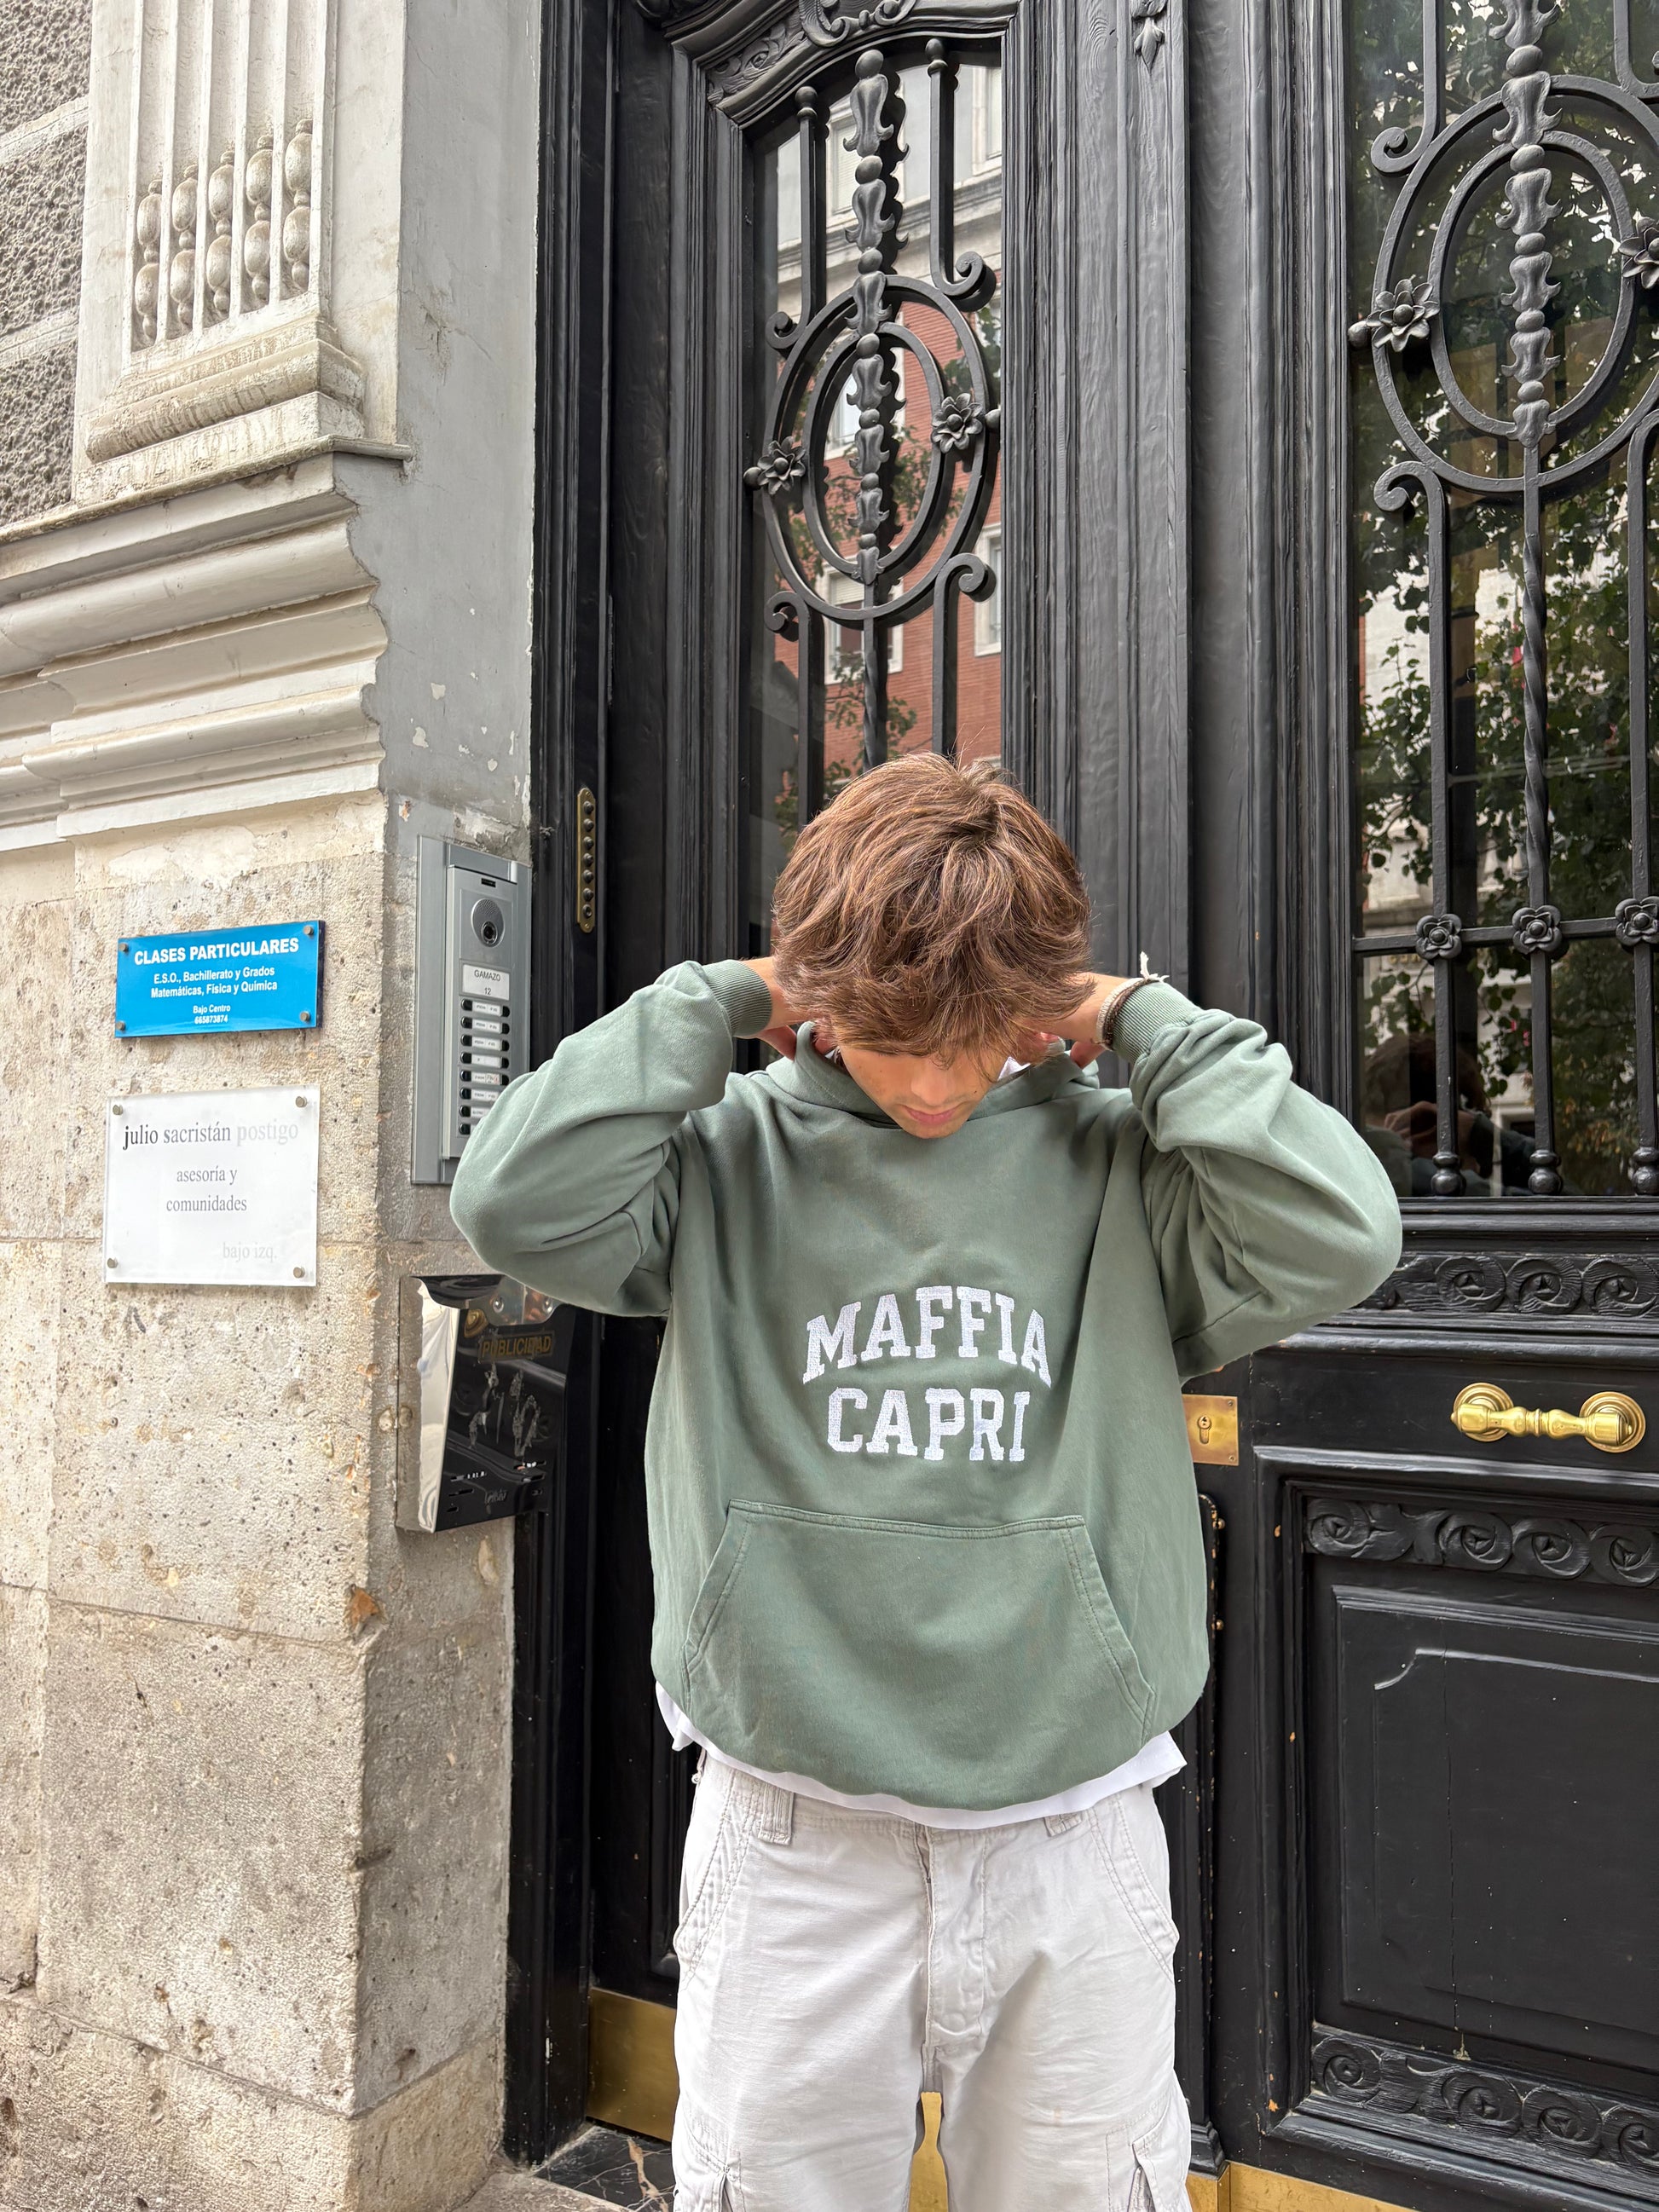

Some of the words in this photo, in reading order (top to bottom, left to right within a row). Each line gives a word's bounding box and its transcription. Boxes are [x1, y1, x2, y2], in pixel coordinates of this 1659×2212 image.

[134, 947, 186, 965] CLASES
[189, 937, 299, 961] PARTICULARES
[153, 972, 182, 985] E.S.O.,
[183, 968, 233, 982] Bachillerato
[234, 970, 241, 981] y
[242, 966, 275, 979] Grados
[474, 969, 501, 982] GAMAZO
[151, 984, 205, 998] Matemáticas,
[206, 982, 232, 995] Física
[234, 984, 240, 996] y
[241, 979, 278, 993] Química
[483, 987, 492, 996] 12
[193, 1005, 208, 1015] Bajo
[209, 1004, 231, 1013] Centro
[123, 1123, 159, 1151] julio
[163, 1121, 231, 1144] sacristán
[236, 1118, 299, 1146] postigo
[176, 1165, 226, 1183] asesoría
[229, 1169, 238, 1186] y
[166, 1194, 247, 1212] comunidades
[223, 1241, 251, 1262] bajo
[254, 1242, 278, 1262] izq.
[482, 1335, 552, 1358] PUBLICIDAD
[801, 1285, 1052, 1389] MAFFIA
[826, 1386, 1031, 1463] CAPRI
